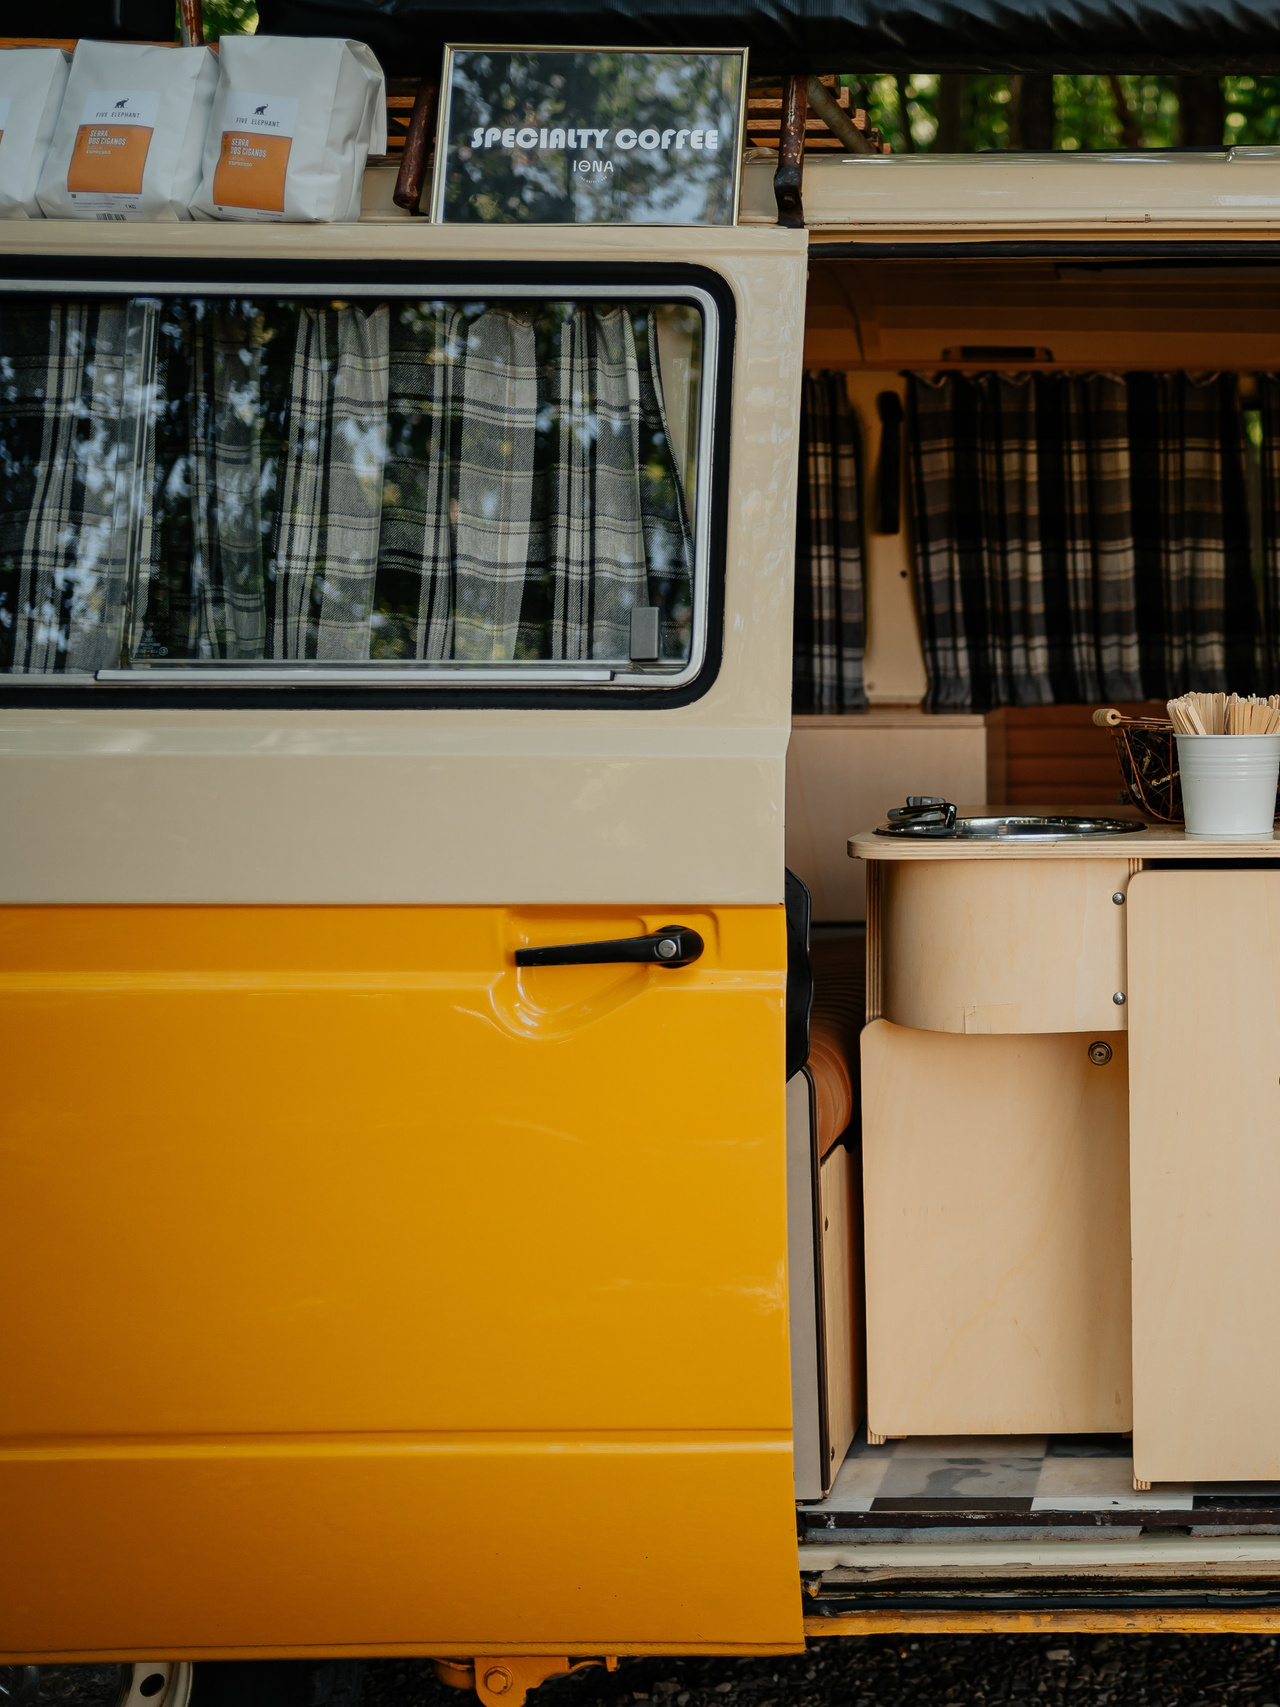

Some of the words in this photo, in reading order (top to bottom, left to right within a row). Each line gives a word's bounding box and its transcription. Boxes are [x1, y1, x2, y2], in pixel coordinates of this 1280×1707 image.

[87, 137, 100, 145] DOS
[231, 138, 249, 147] SERRA
[470, 127, 609, 149] SPECIALTY
[615, 128, 719, 150] COFFEE
[230, 146, 241, 155] DOS
[242, 147, 267, 158] CIGANOS
[573, 160, 614, 172] IONA
